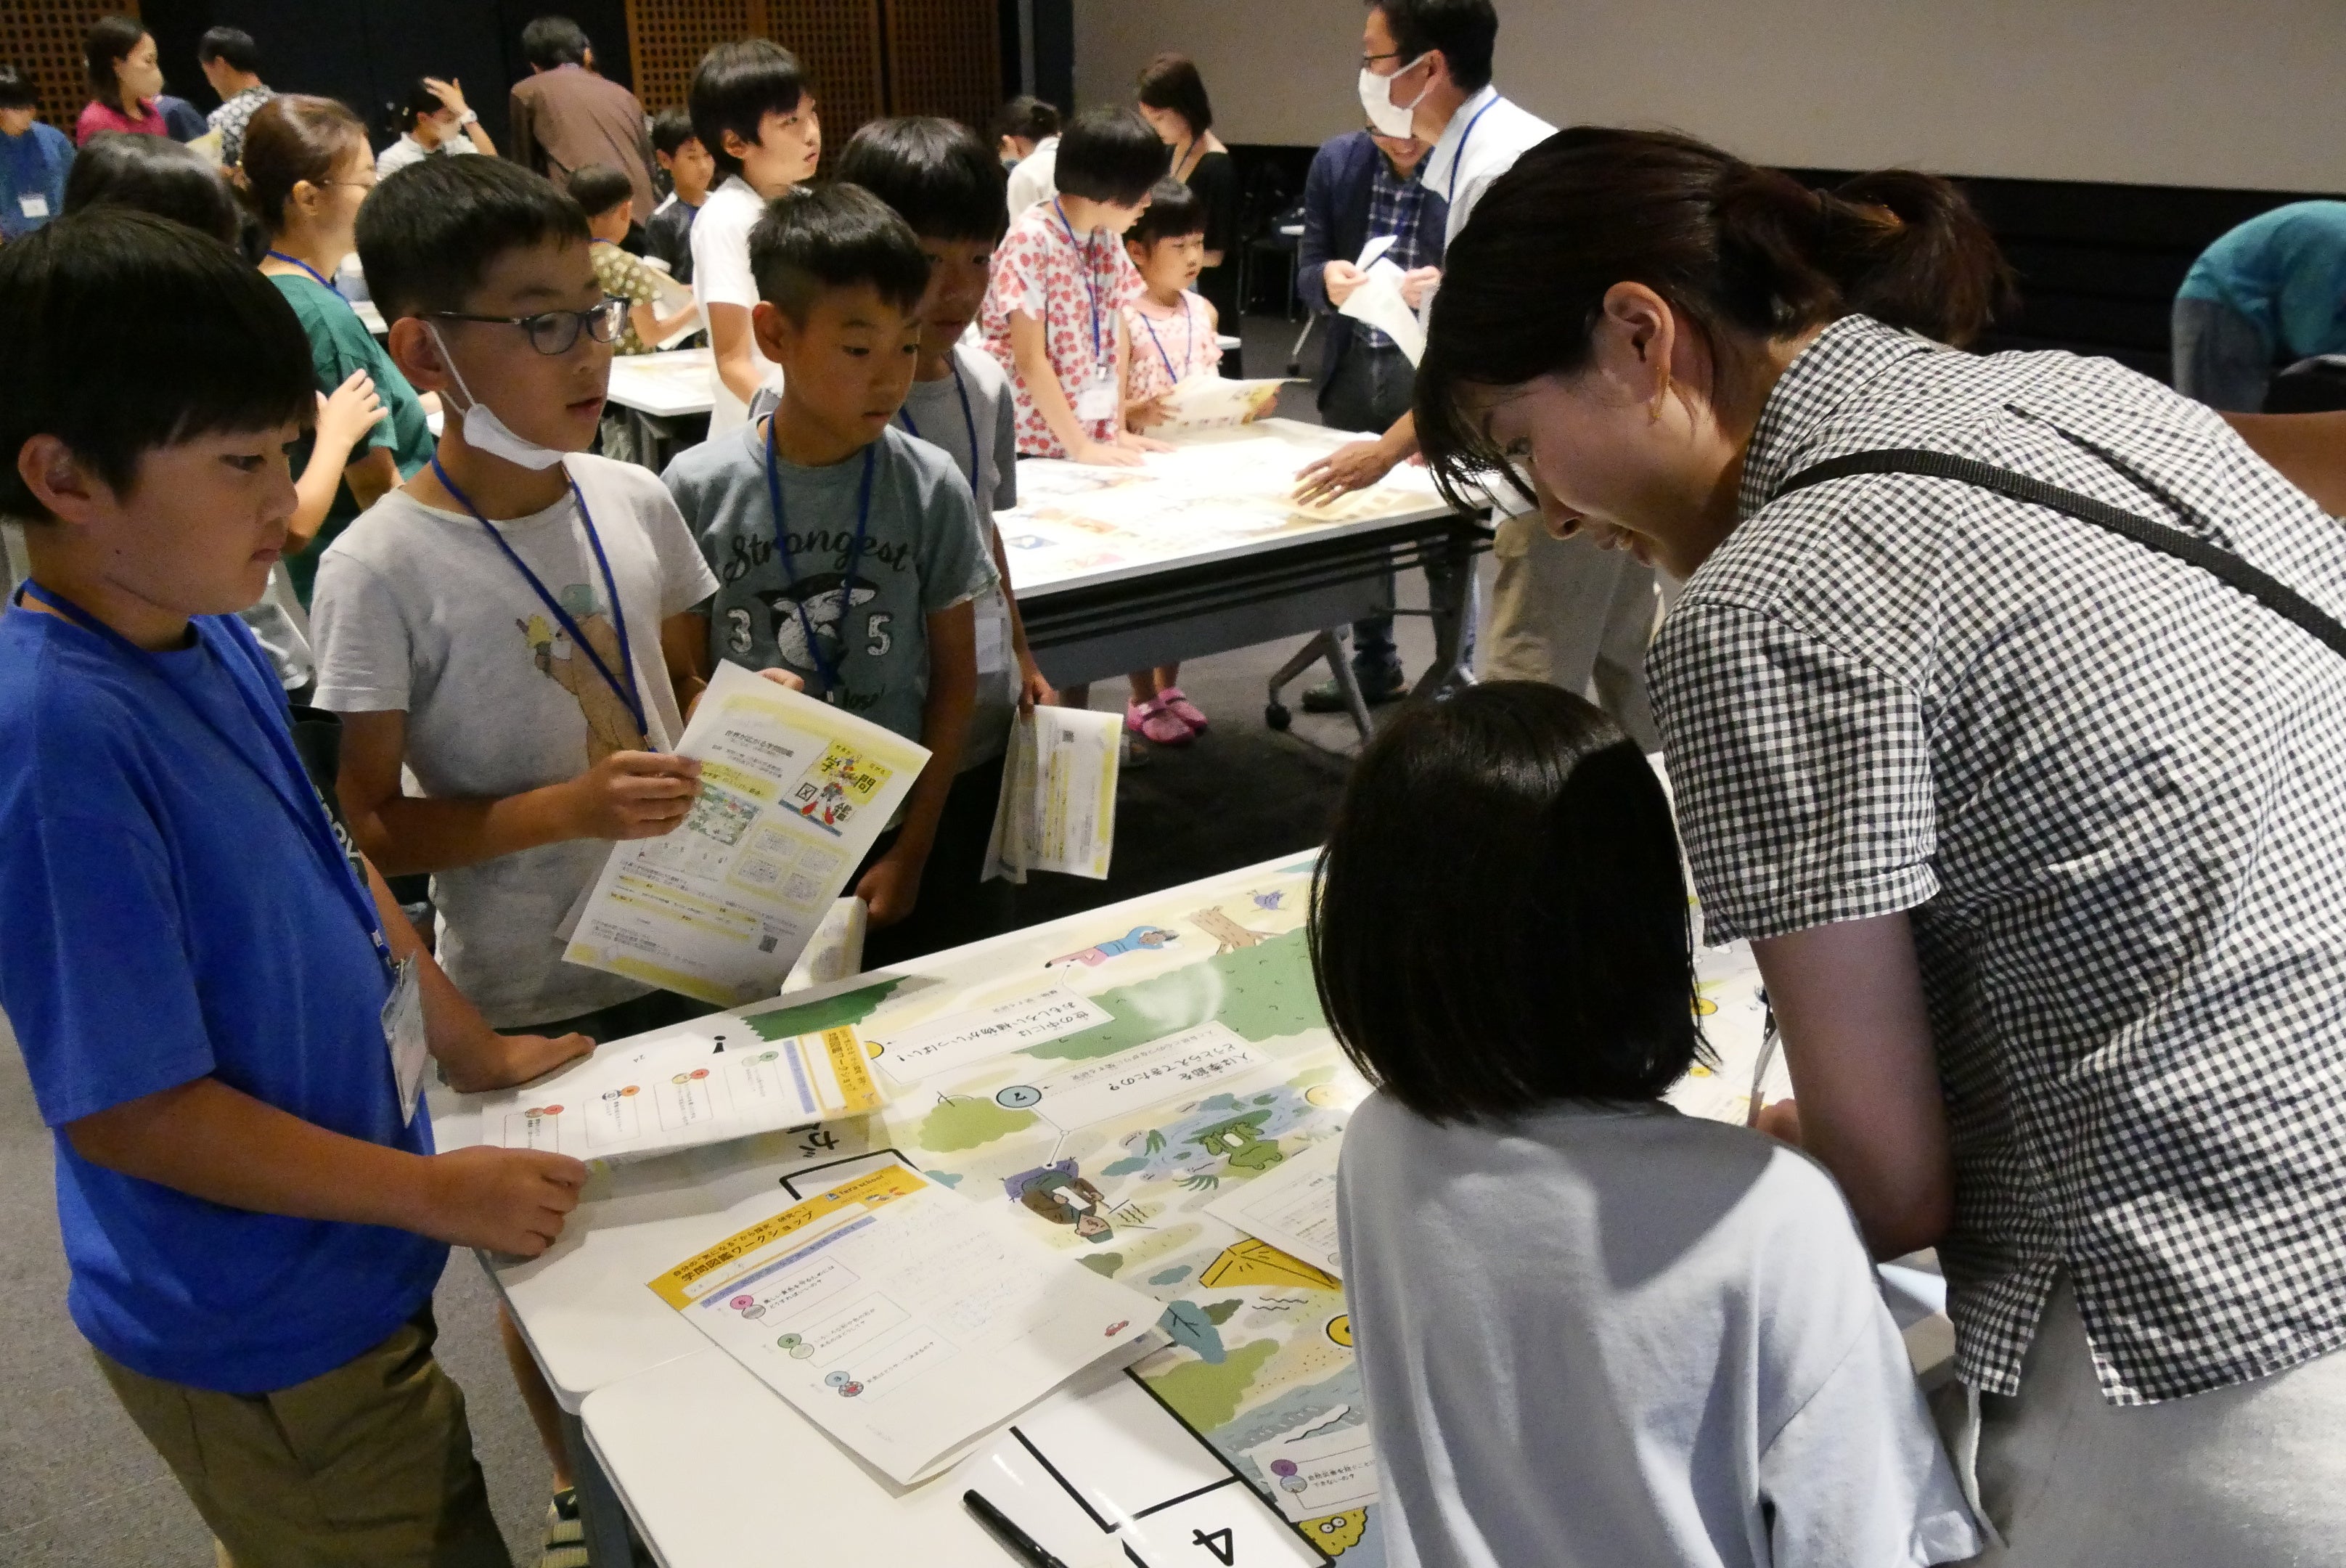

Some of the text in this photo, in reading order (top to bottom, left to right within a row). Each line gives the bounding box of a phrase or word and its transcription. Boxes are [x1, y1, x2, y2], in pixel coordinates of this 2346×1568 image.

[727, 608, 894, 656] 3 5
[1018, 1011, 1088, 1037] 世の中には
[1179, 1053, 1247, 1080] 人は季節を
[1193, 1527, 1233, 1567] 4
